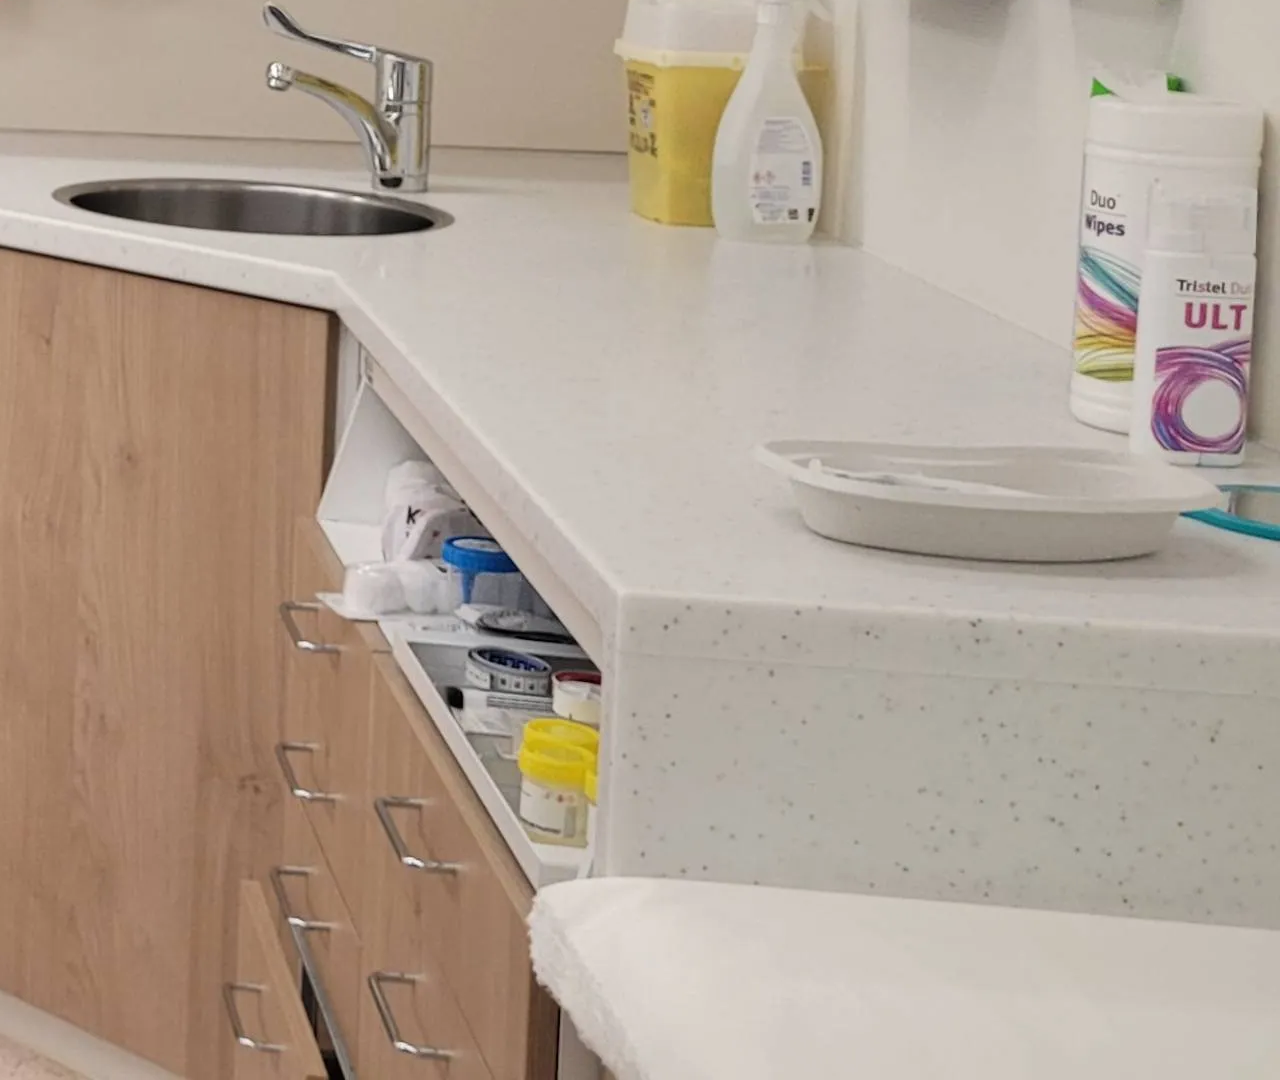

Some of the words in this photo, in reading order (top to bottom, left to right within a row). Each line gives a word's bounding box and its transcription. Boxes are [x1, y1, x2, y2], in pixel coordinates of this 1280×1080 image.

[1090, 190, 1116, 210] Duo
[1085, 214, 1126, 237] Wipes
[1176, 279, 1227, 294] Tristel
[1184, 302, 1248, 331] ULT
